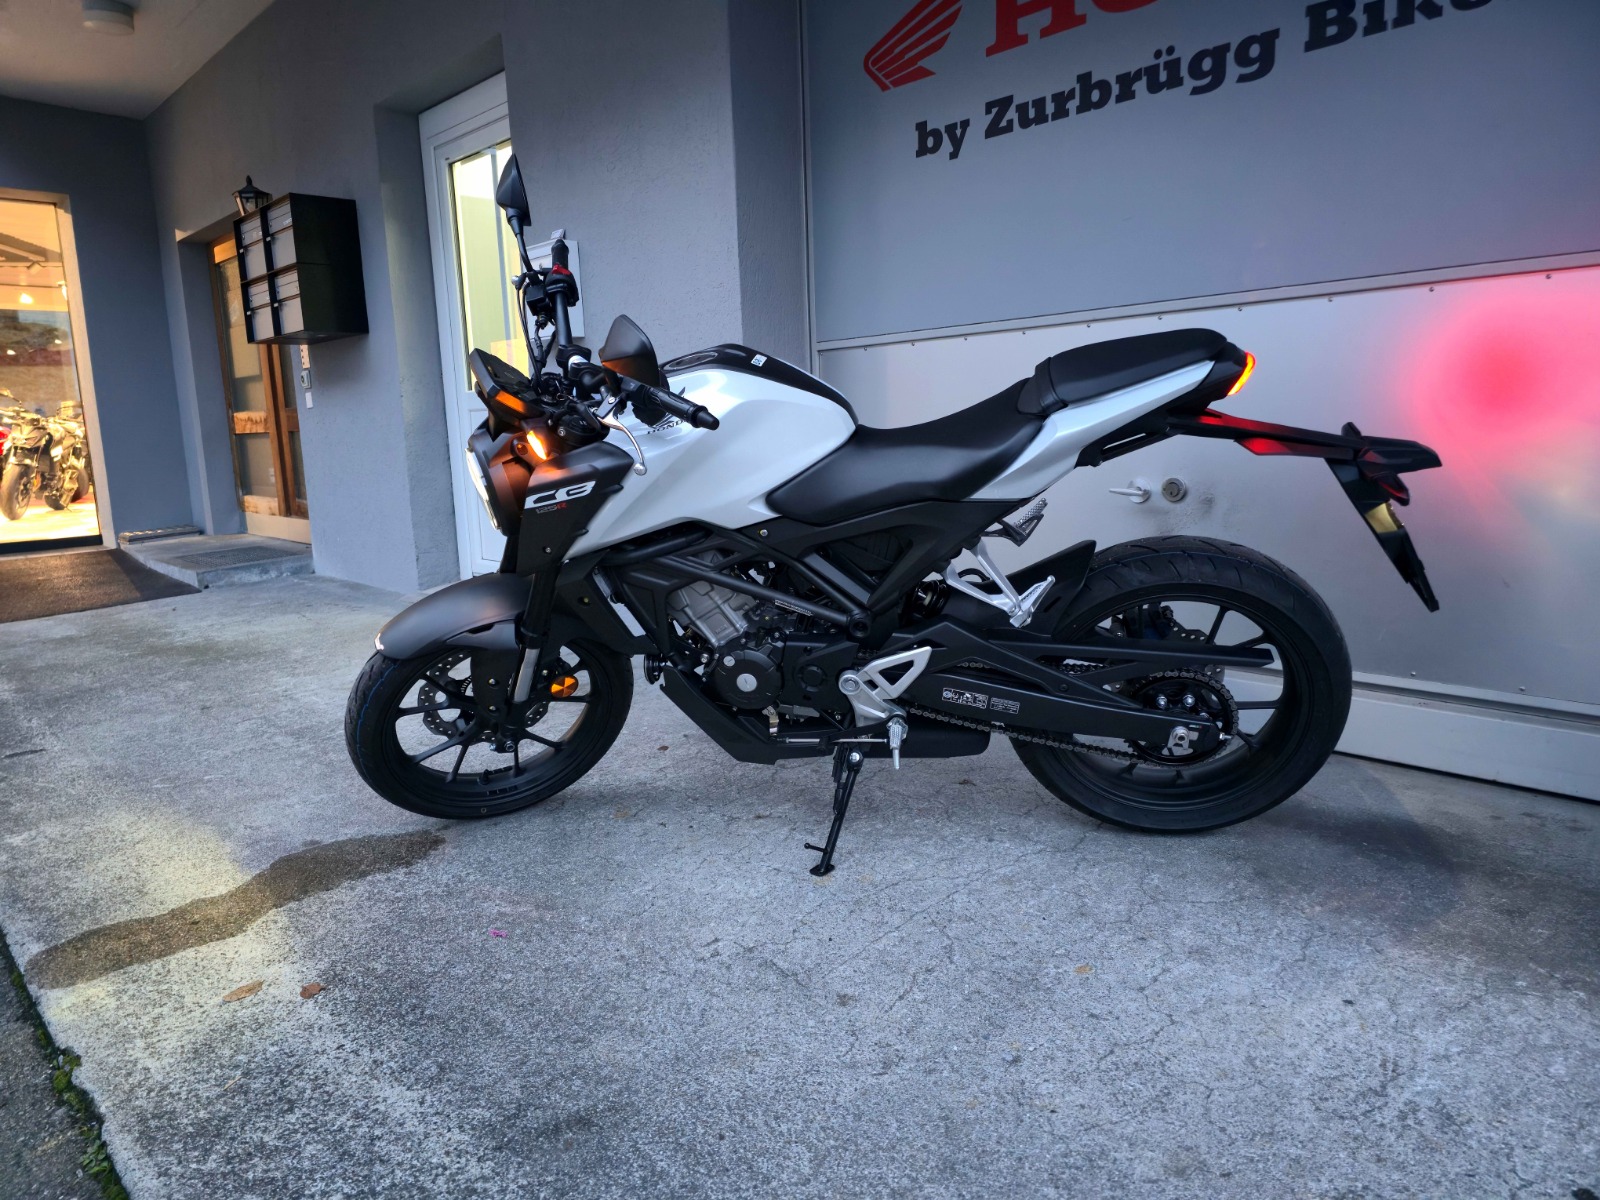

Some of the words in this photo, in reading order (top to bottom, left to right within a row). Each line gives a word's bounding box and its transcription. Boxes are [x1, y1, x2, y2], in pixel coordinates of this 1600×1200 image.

[915, 119, 970, 160] by
[984, 27, 1280, 139] Zurbrügg
[524, 480, 596, 509] CB
